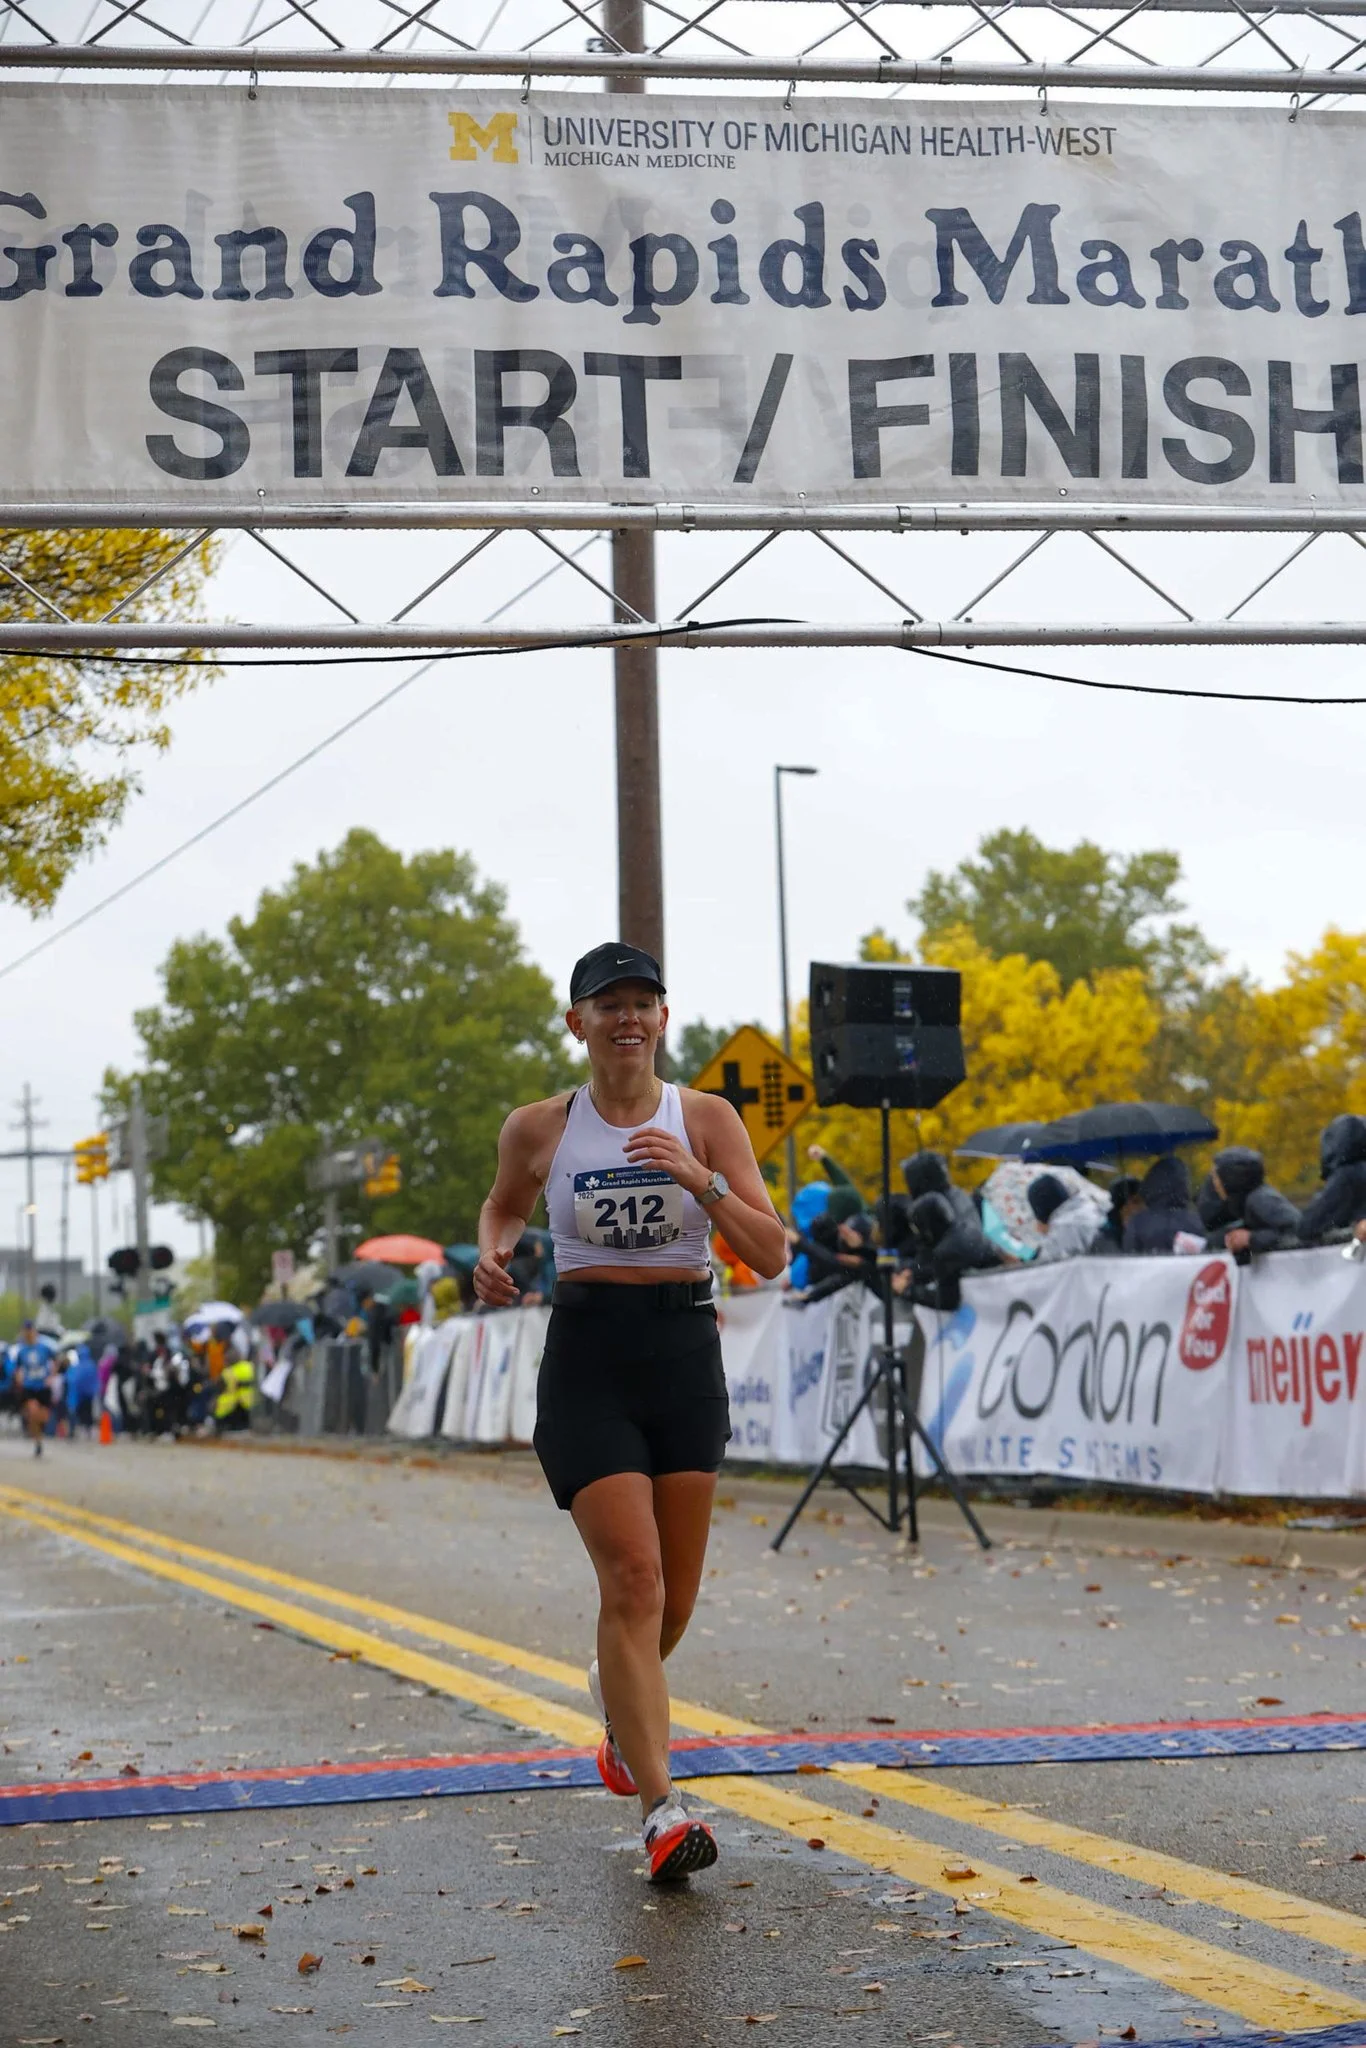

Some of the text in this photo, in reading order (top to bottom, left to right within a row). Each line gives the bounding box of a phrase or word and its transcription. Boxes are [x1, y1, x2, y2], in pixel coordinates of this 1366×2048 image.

[543, 115, 1117, 157] UNIVERSITY OF MICHIGAN HEALTH-WEST
[543, 152, 736, 170] MICHIGAN MEDICINE
[428, 190, 887, 326] Rapids
[145, 345, 1365, 485] START / FINISH
[577, 1191, 595, 1200] 2025
[601, 1176, 671, 1187] Grand Rapids Marathon
[594, 1194, 666, 1228] 212
[979, 1282, 1172, 1427] Gordon
[1246, 1311, 1365, 1428] meijer
